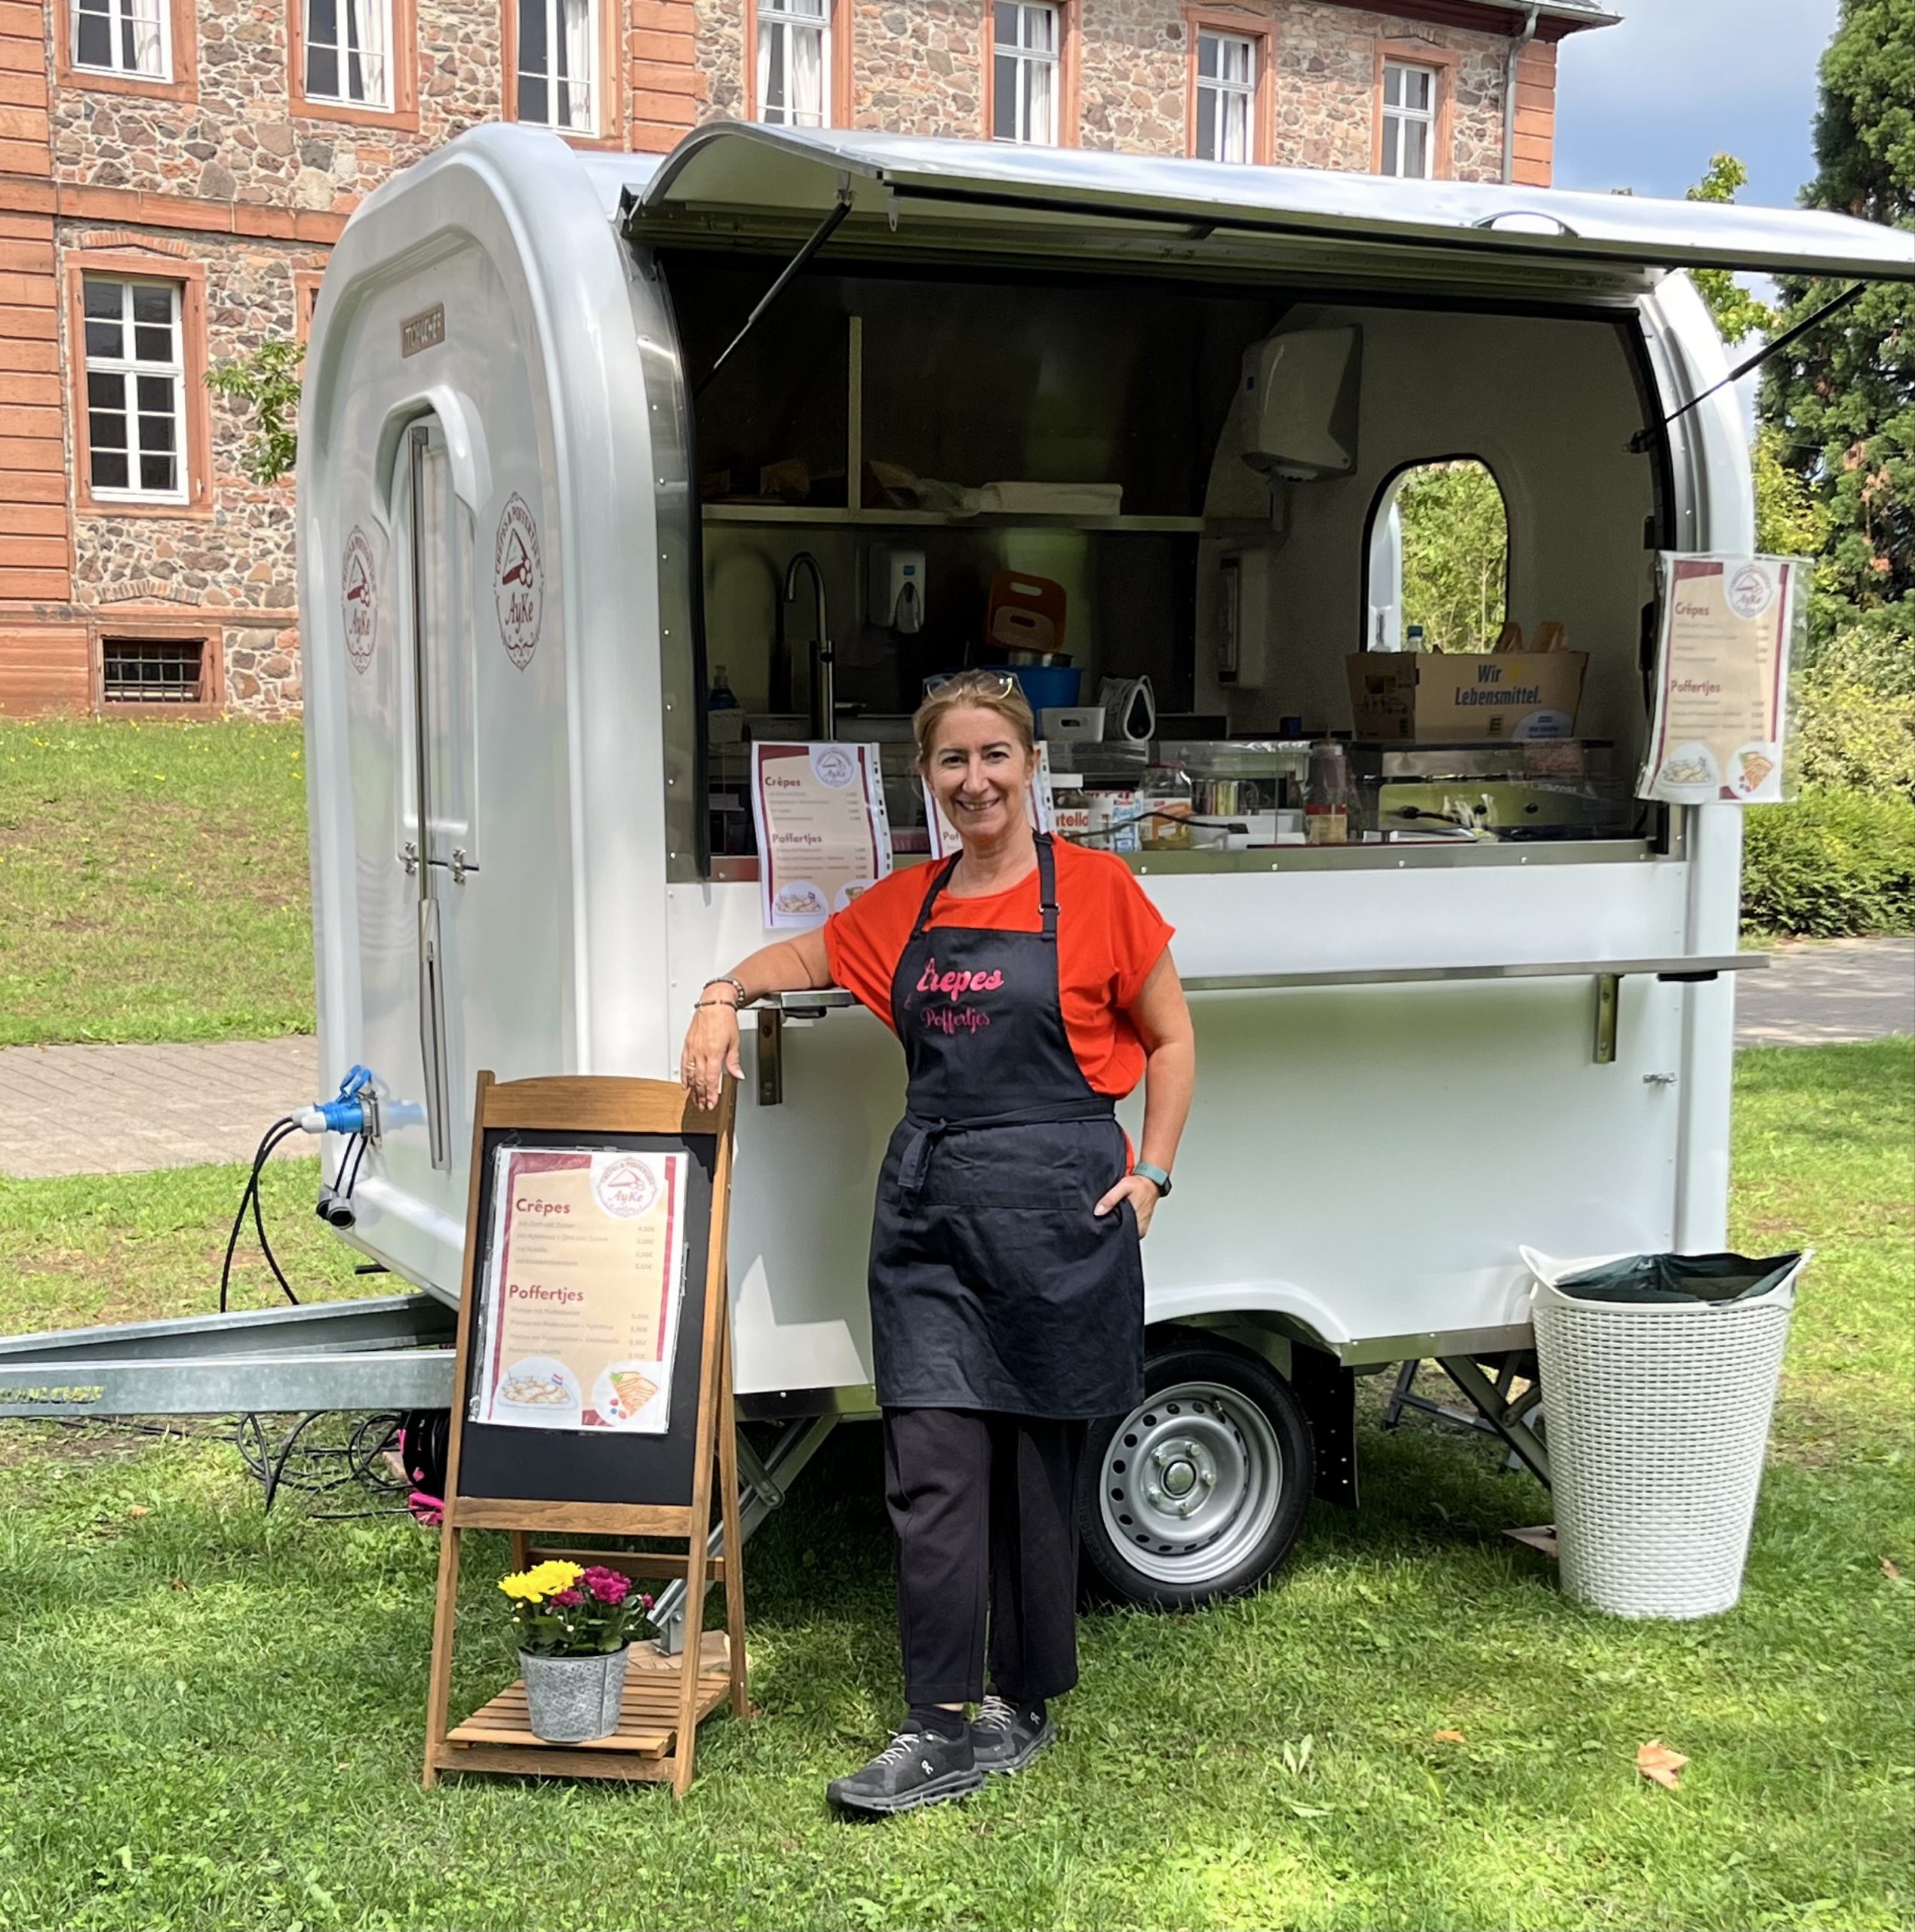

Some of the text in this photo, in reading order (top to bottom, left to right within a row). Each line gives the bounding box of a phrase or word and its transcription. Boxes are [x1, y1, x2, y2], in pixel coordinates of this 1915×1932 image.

[505, 592, 534, 635] AyKe
[1674, 601, 1710, 620] Crêpes
[1477, 664, 1502, 683] Wir
[1454, 685, 1542, 706] Lebensmittel.
[1670, 680, 1722, 697] Poffertjes
[764, 776, 801, 790] Crêpes
[772, 832, 822, 845] Poffertjes
[921, 1007, 991, 1034] Poffertjes
[607, 1189, 644, 1205] AyKe
[515, 1198, 571, 1217] Crêpes
[509, 1284, 584, 1305] Poffertjes
